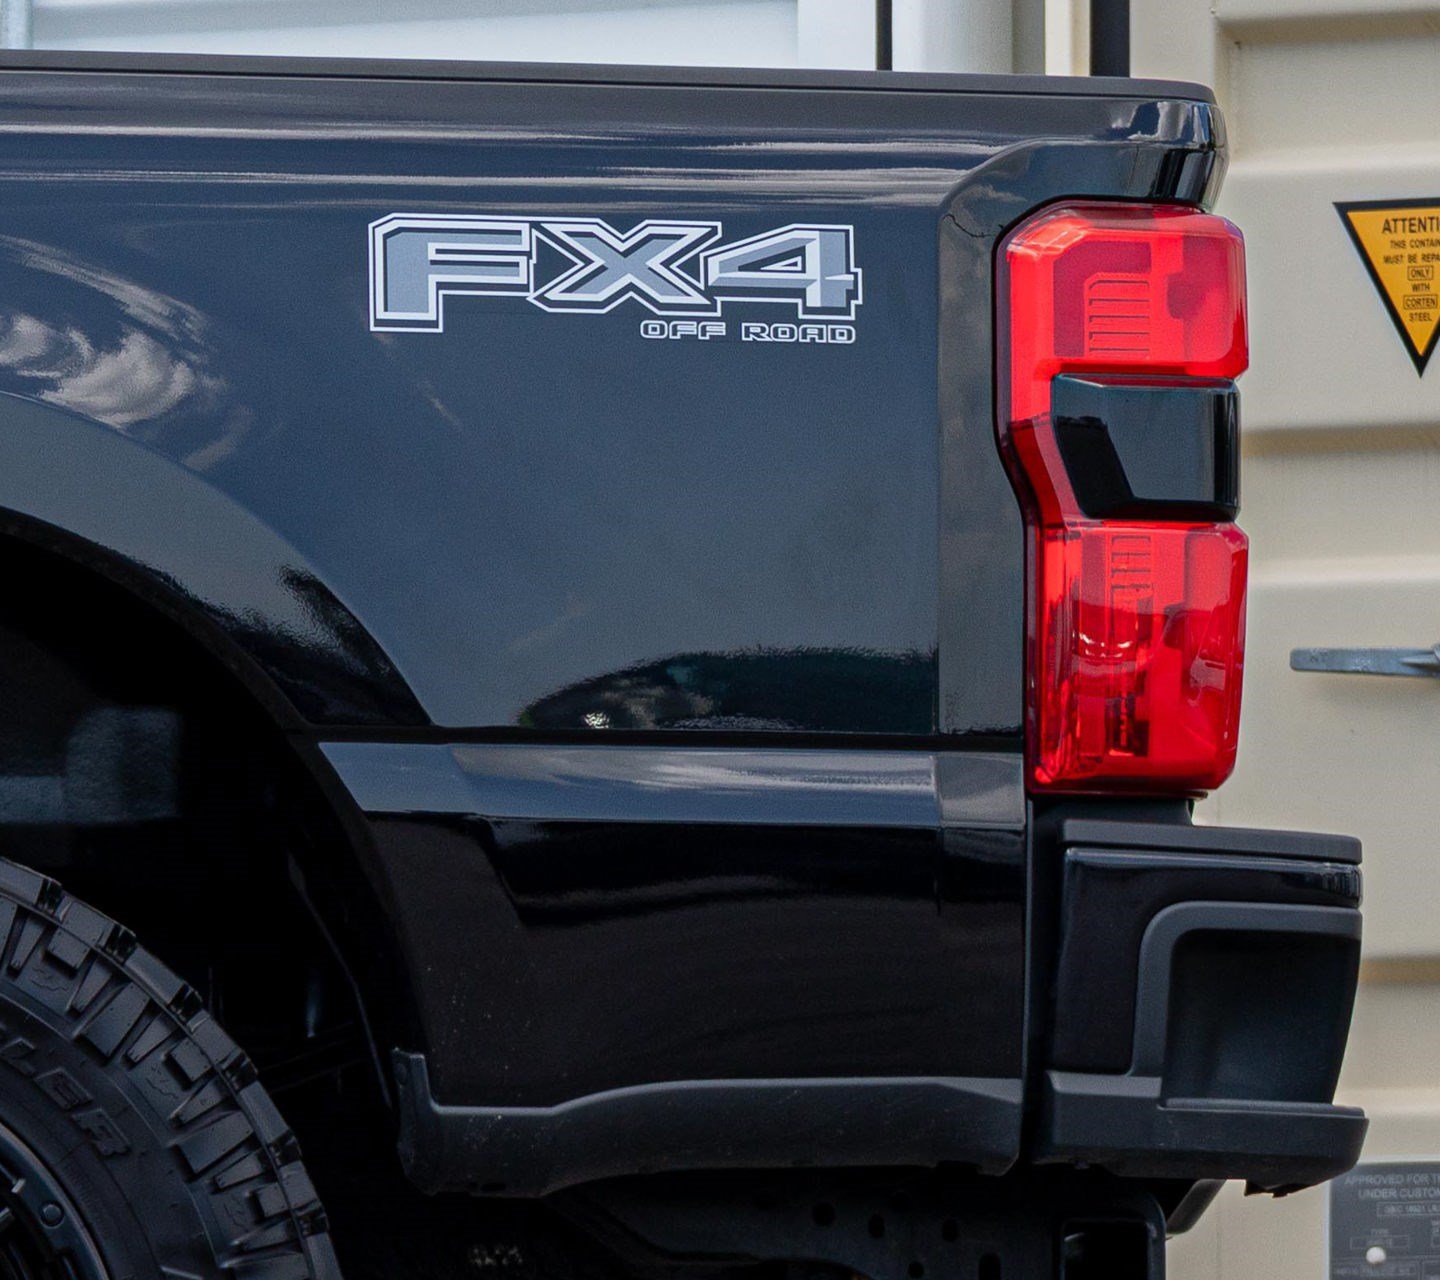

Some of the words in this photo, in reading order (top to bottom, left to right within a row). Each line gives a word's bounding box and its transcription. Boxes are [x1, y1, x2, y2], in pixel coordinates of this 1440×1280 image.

[1390, 240, 1406, 249] THIS
[1383, 255, 1403, 264] MUST
[1407, 253, 1418, 263] BE
[368, 213, 863, 333] FX4
[1410, 268, 1430, 278] ONLY
[1412, 283, 1430, 292] WITH
[1405, 297, 1436, 308] CORTEN
[1409, 312, 1432, 322] STEEL
[639, 320, 726, 341] OFF
[741, 322, 856, 344] ROAD
